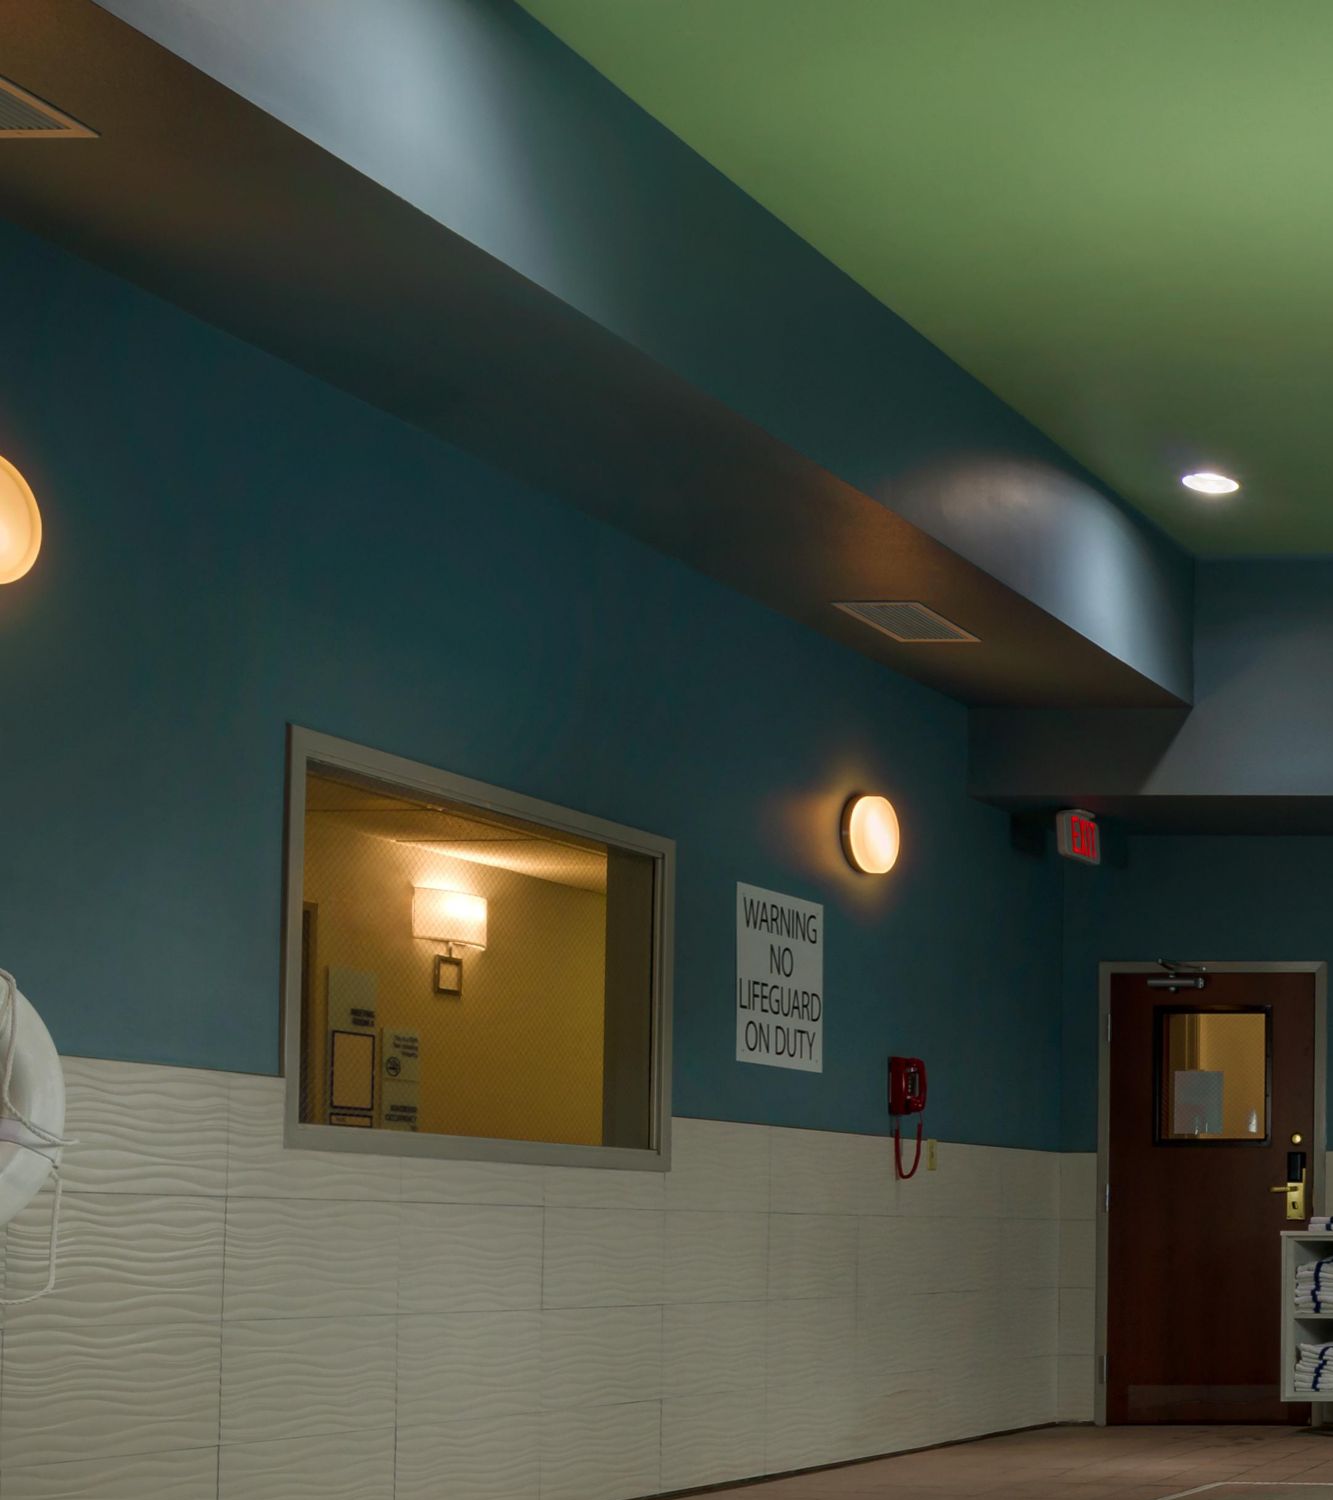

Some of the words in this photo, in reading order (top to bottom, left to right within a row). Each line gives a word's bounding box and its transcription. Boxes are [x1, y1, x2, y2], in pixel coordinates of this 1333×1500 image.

[1071, 816, 1097, 860] EXIT
[743, 896, 818, 944] WARNING
[769, 943, 794, 978] NO
[739, 977, 822, 1022] LIFEGUARD
[744, 1020, 770, 1054] ON
[775, 1025, 816, 1060] DUTY
